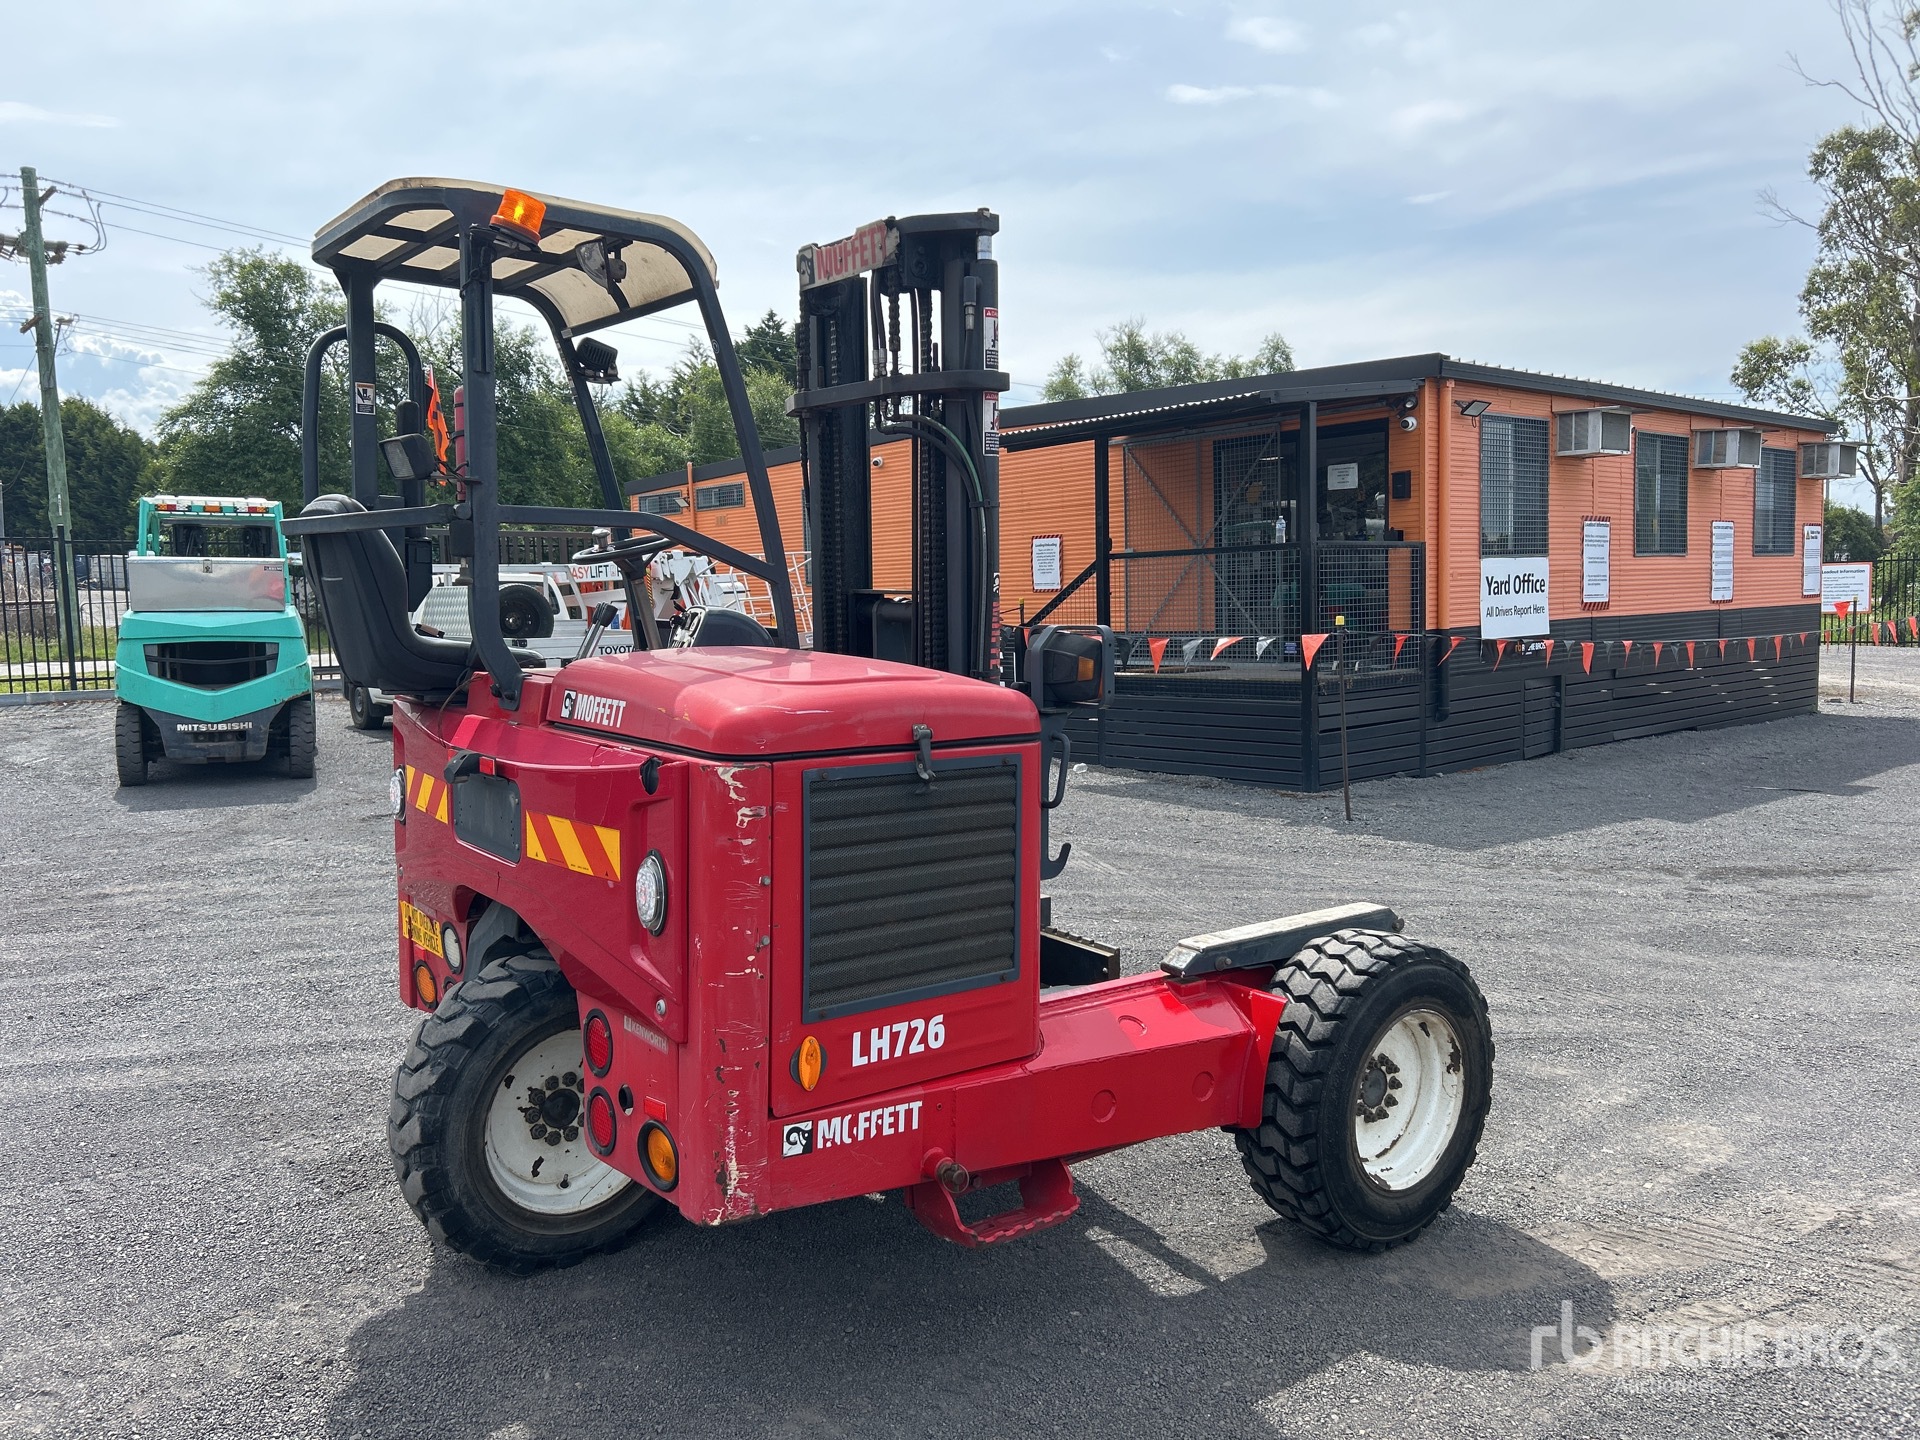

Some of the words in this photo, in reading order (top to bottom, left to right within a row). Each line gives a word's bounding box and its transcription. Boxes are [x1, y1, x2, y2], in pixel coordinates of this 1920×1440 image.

[571, 564, 609, 580] ASYLIFT
[1485, 574, 1511, 595] Yard
[1513, 573, 1545, 594] Office
[1486, 606, 1494, 617] All
[1495, 606, 1513, 618] Drivers
[1513, 604, 1532, 619] Report
[1532, 604, 1545, 614] Here
[574, 693, 626, 728] MOFFETT
[176, 721, 253, 732] MITSUBISHI
[631, 1020, 668, 1052] KENWORTH
[852, 1014, 946, 1067] LH726
